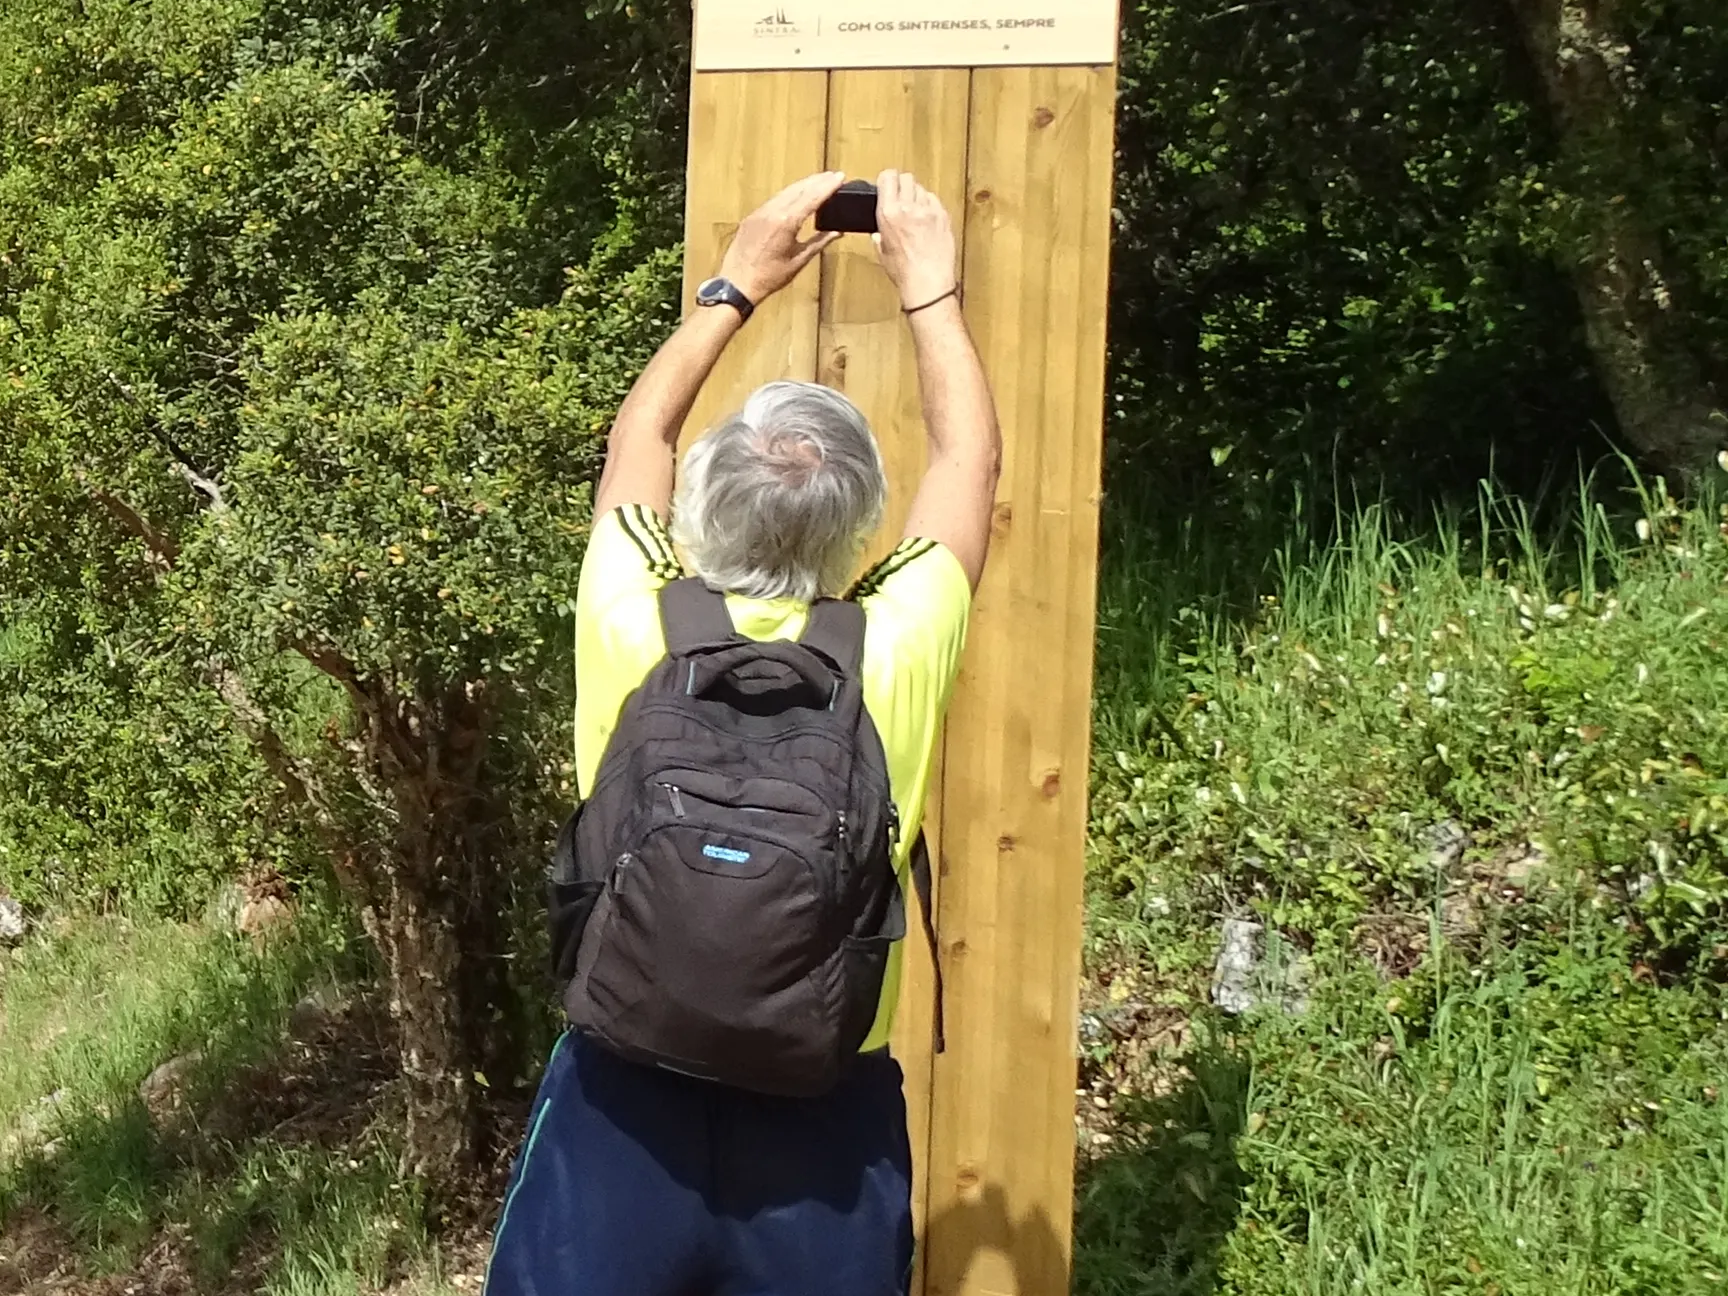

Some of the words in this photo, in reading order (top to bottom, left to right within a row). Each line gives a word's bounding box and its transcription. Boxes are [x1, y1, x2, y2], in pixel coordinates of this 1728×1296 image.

[838, 22, 871, 32] COM
[874, 21, 894, 32] OS
[898, 19, 991, 31] SINTRENSES,
[996, 18, 1055, 29] SEMPRE
